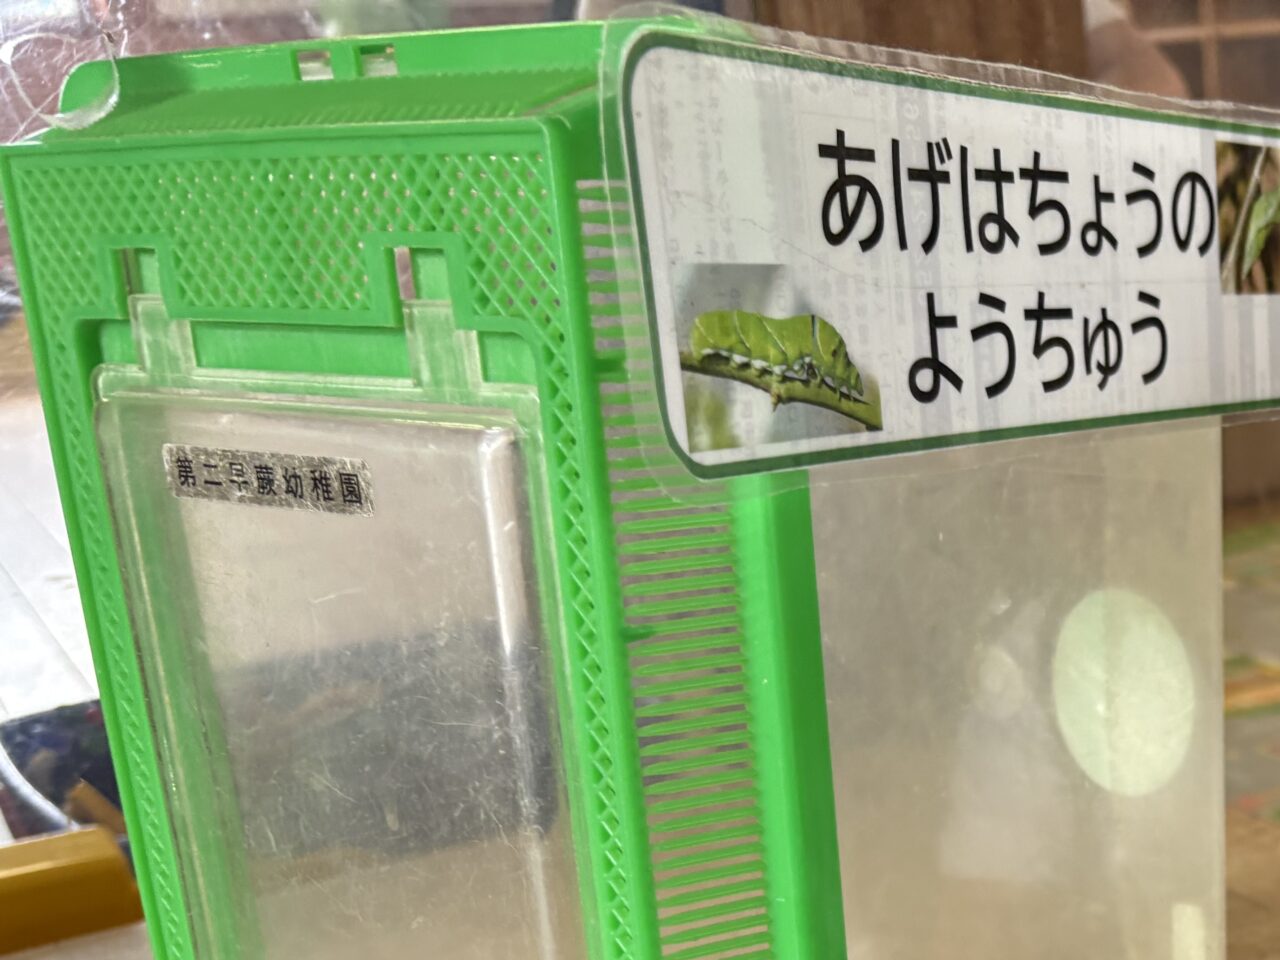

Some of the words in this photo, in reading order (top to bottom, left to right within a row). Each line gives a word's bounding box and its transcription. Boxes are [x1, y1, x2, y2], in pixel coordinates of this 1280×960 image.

[818, 128, 1216, 258] あげはちょうの
[908, 290, 1168, 404] ようちゅう
